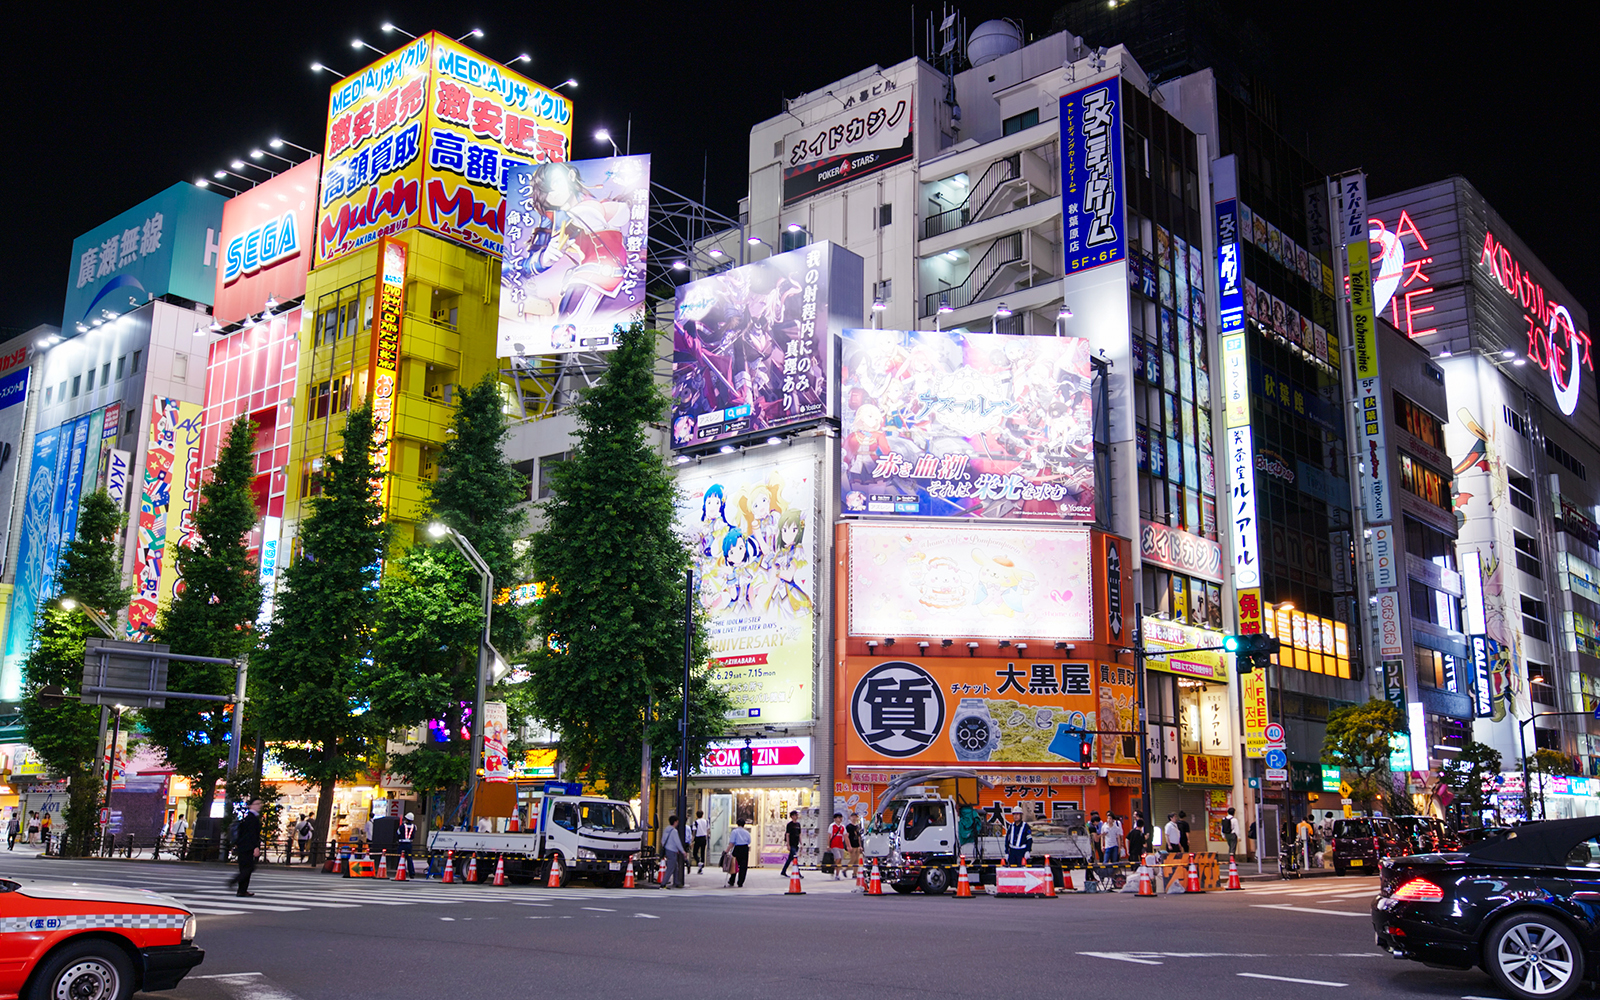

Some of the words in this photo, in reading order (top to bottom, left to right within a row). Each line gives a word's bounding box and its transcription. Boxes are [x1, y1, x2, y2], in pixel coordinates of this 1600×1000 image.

[328, 76, 426, 157] 激安販売
[436, 79, 566, 164] 激安販売
[790, 100, 906, 166] メイドカジノ
[1067, 108, 1077, 189] トレーディングカードゲーム
[323, 123, 419, 207] 高額買取
[818, 169, 840, 182] POKER
[851, 153, 875, 170] STARS
[518, 172, 535, 227] いつでも
[440, 221, 482, 243] ムーラン
[1067, 203, 1080, 253] 秋葉原店
[222, 210, 300, 284] SEGA
[327, 240, 355, 260] ムーラン
[354, 231, 377, 248] AKIBA
[384, 284, 401, 297] DVD
[1143, 276, 1156, 297] 7F
[1351, 270, 1365, 307] Yellow
[381, 303, 400, 316] ゲーム
[383, 313, 396, 324] CD
[795, 249, 821, 392] 我の射程内にのみ
[379, 331, 398, 343] アニメ
[1226, 338, 1241, 350] 3F
[1354, 313, 1369, 373] Submarine
[782, 340, 798, 412] 真理あり
[1147, 361, 1160, 381] 6F
[1362, 379, 1374, 388] 5F
[1263, 373, 1305, 415] 秋葉館
[1364, 396, 1379, 435] 秋葉館
[1151, 450, 1164, 472] 5F
[926, 472, 1067, 501] それは栄光を求む
[1068, 503, 1092, 513] Yostar
[1142, 525, 1222, 576] メイドカジノ
[1375, 529, 1392, 585] amiami
[763, 622, 777, 630] DAYS
[1380, 594, 1398, 646] あみあみ
[950, 682, 991, 695] チケット
[995, 662, 1092, 696] 大黒屋
[1473, 636, 1491, 715] GALLERIA
[863, 675, 936, 745] 質
[1256, 686, 1266, 728] FREE
[1211, 703, 1222, 747] ルノアール
[1268, 728, 1281, 738] 40
[757, 748, 779, 765] ZIN
[1186, 755, 1209, 777] 免税
[1210, 756, 1219, 772] TAX
[1219, 757, 1230, 772] FREE
[1270, 754, 1278, 767] P
[852, 772, 888, 783] 高価買取
[1004, 785, 1058, 798] チケット
[1062, 774, 1095, 785] 無料査定
